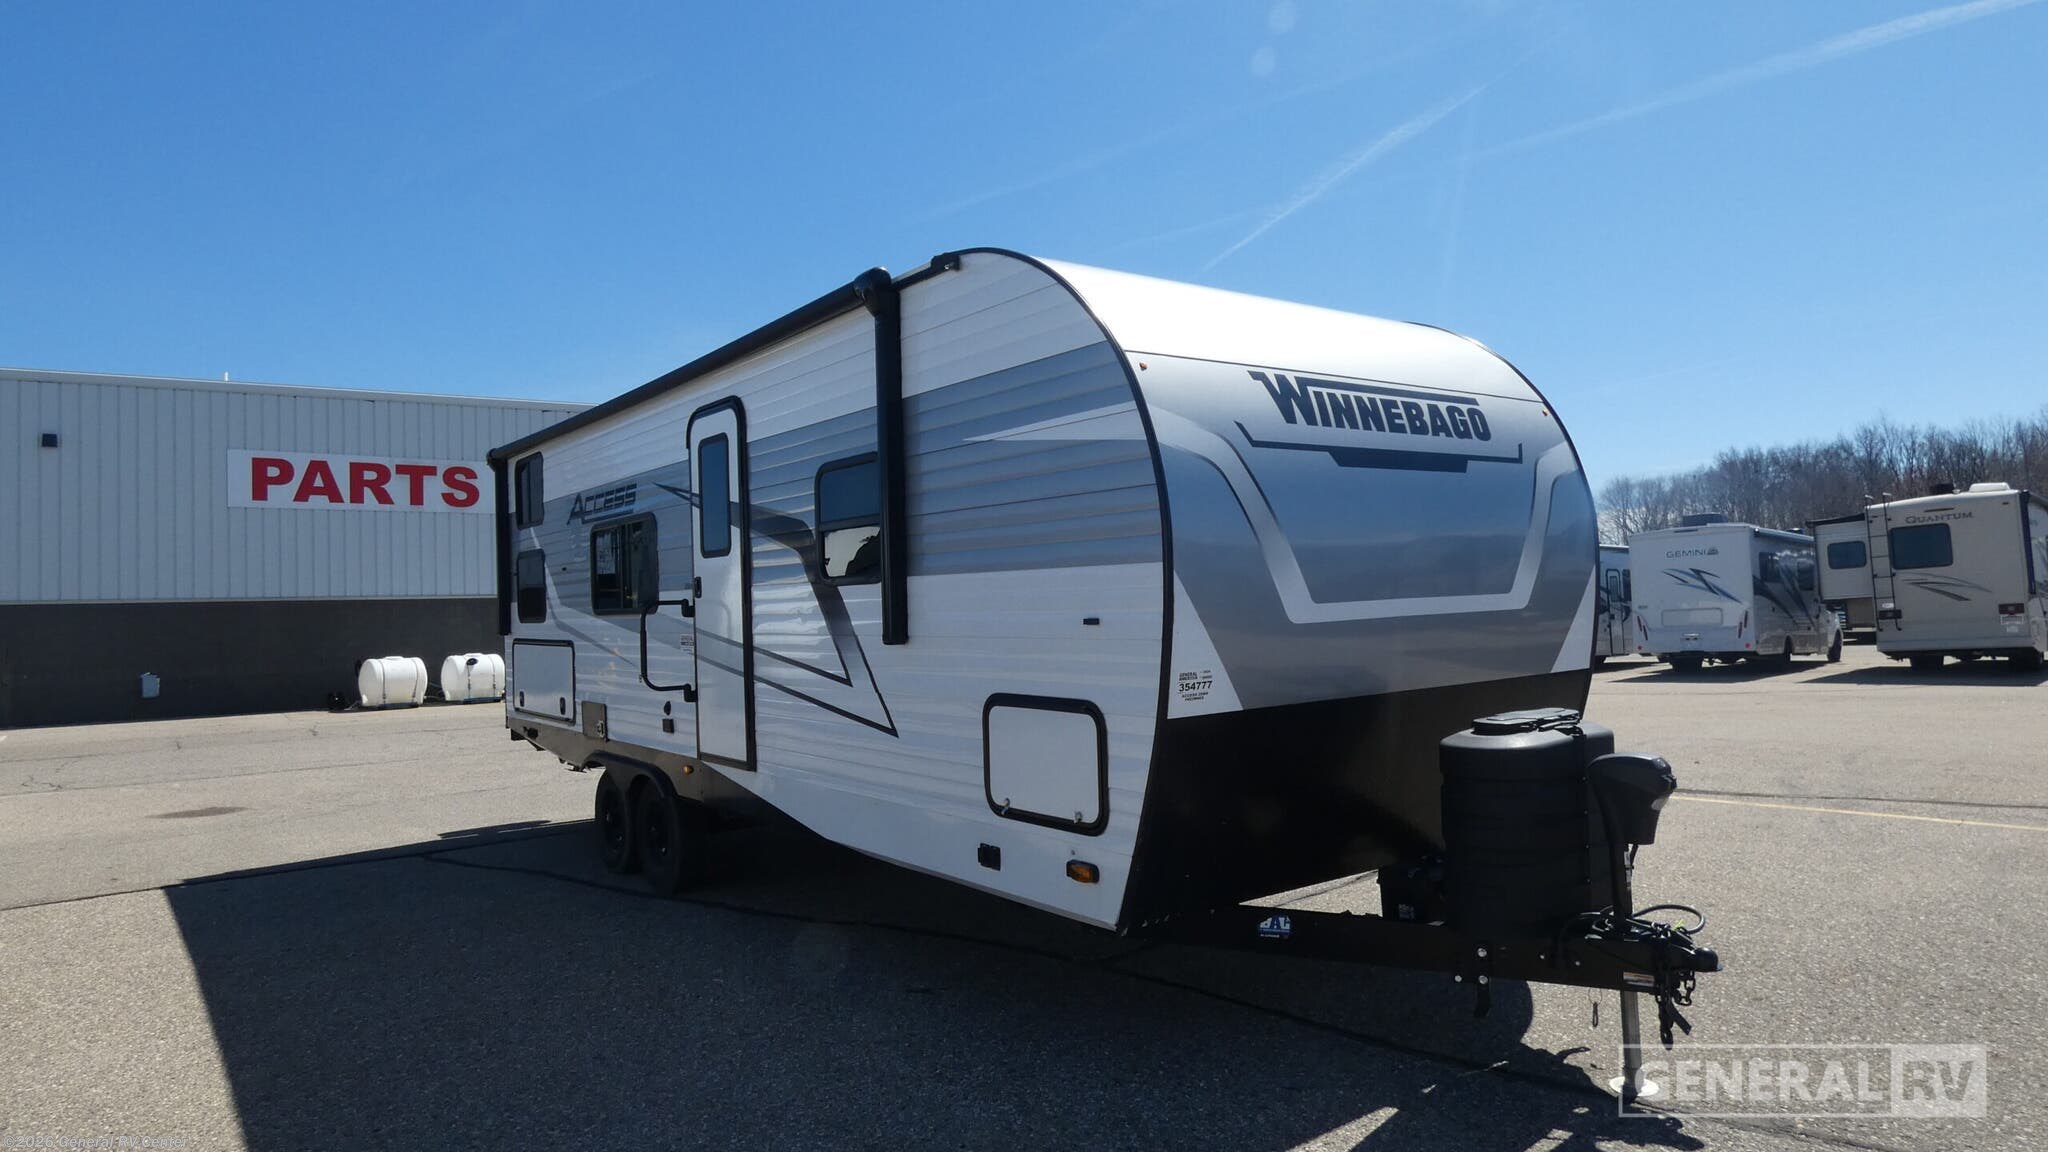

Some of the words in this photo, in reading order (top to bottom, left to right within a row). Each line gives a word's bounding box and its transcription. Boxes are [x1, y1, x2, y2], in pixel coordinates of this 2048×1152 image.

[1247, 370, 1492, 442] WINNEBAGO
[251, 457, 481, 508] PARTS
[566, 483, 638, 526] ACCESS
[1905, 511, 1975, 524] QUANTUM
[1666, 549, 1706, 559] GEMINI
[1179, 680, 1213, 692] 354777
